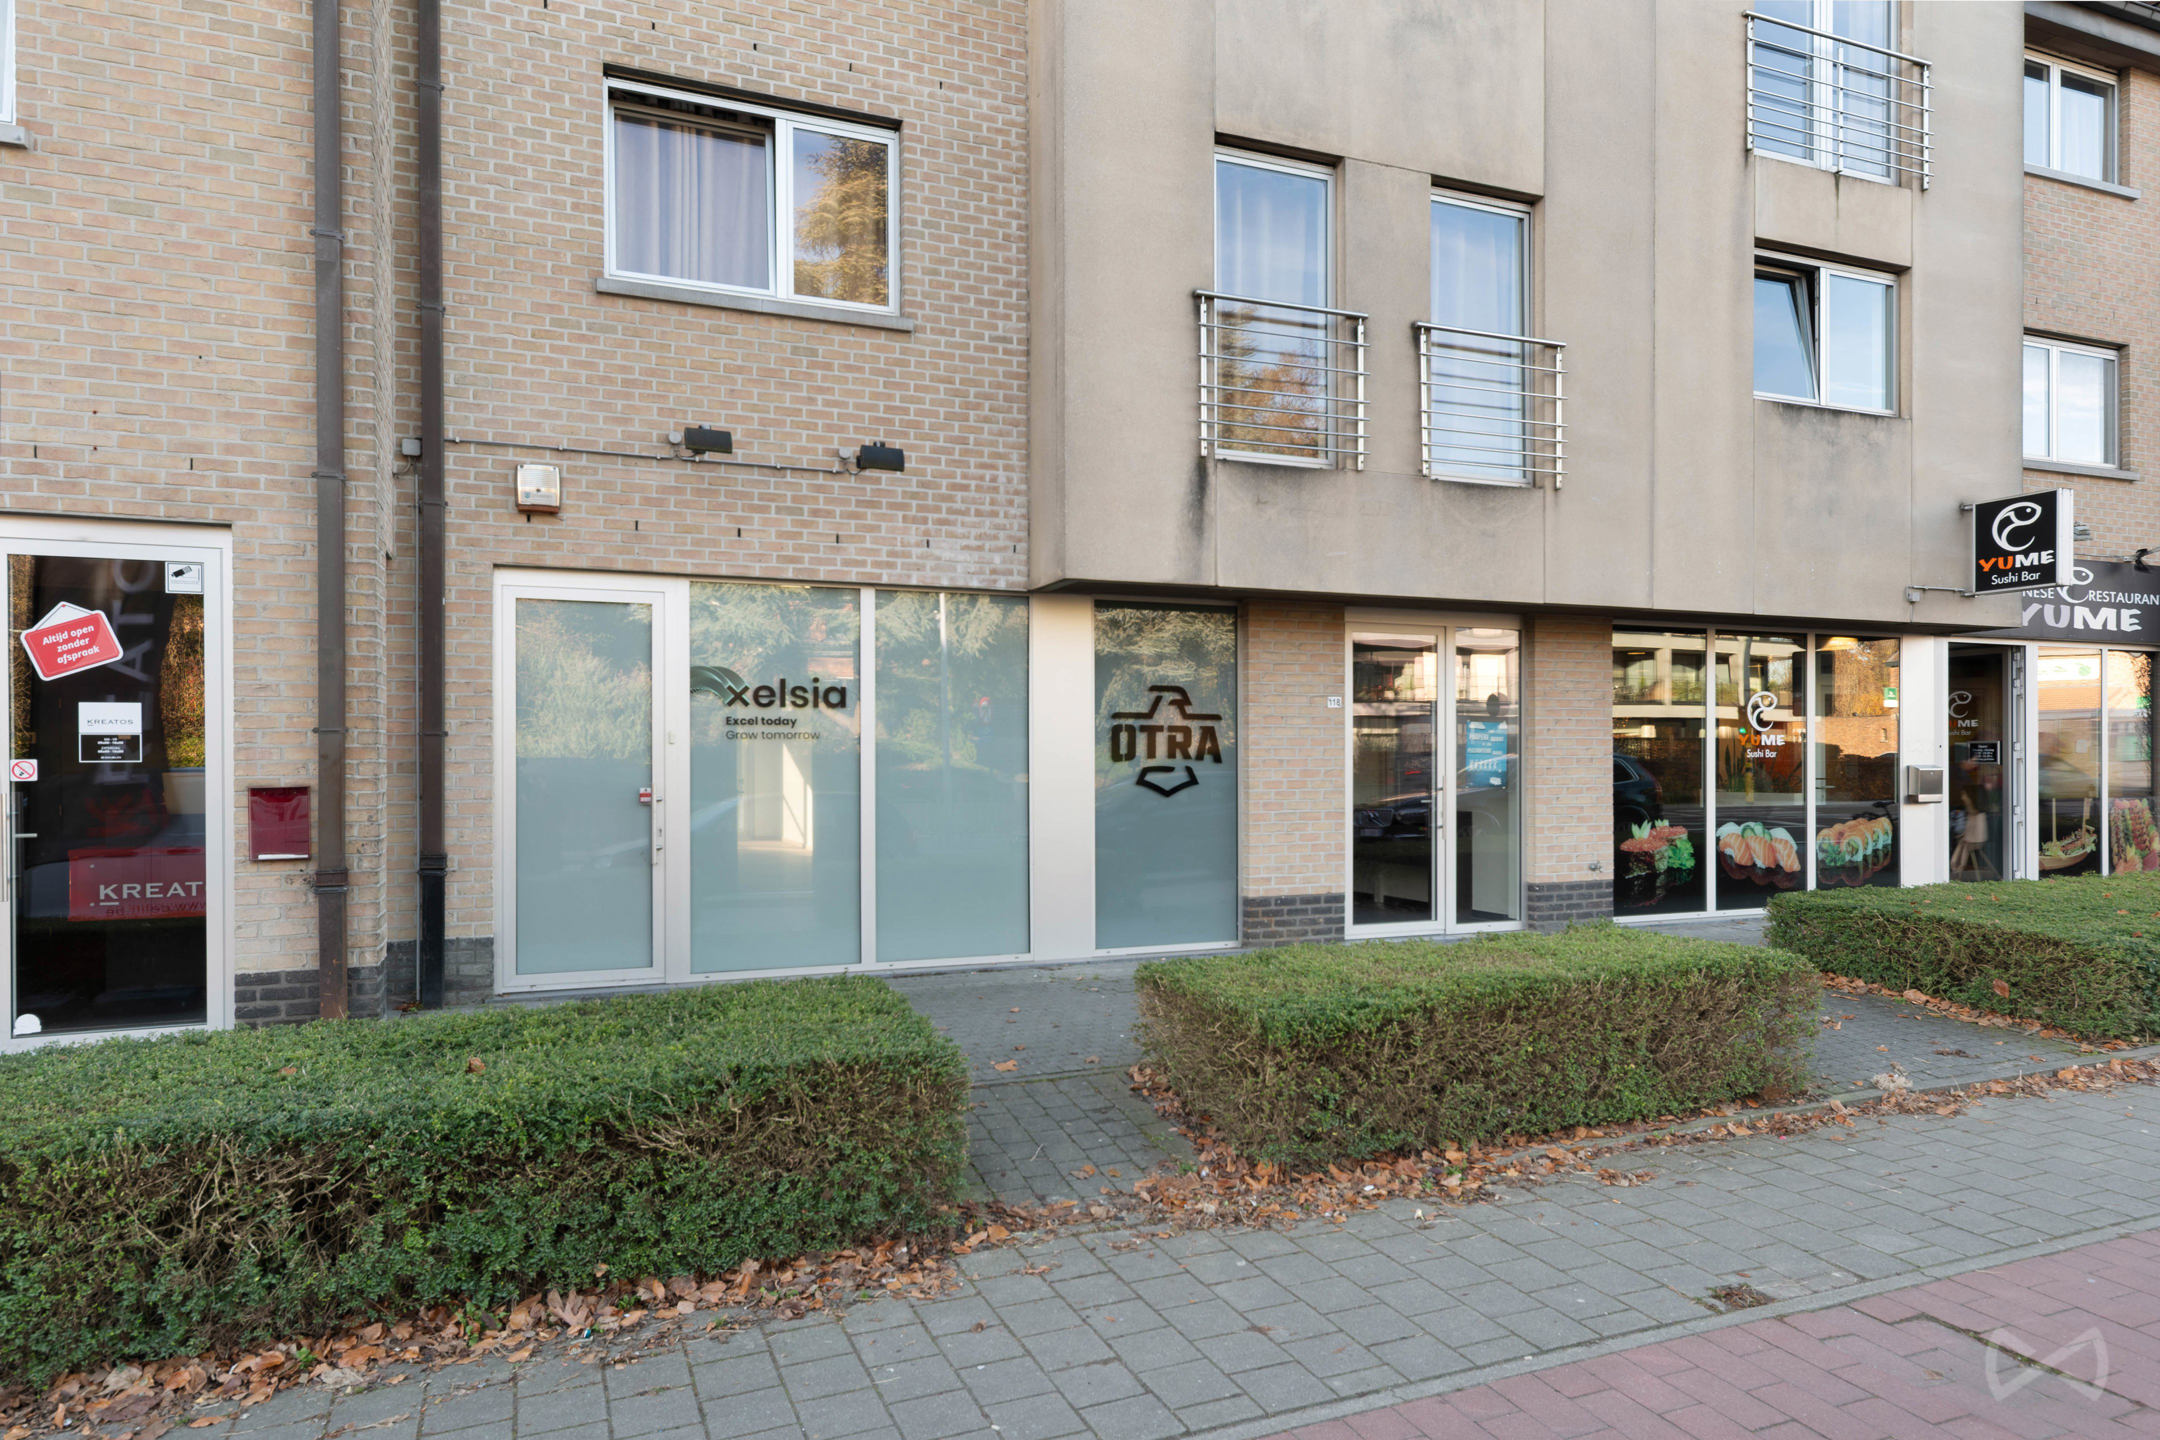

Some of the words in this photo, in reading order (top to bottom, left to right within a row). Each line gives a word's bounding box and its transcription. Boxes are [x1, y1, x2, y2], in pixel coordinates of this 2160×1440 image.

[1978, 549, 2055, 572] YUME
[1991, 572, 2018, 585] Sushi
[2021, 571, 2041, 582] Bar
[2022, 587, 2055, 599] NESE
[2088, 589, 2160, 606] RESTAURAN
[2022, 603, 2142, 632] YUME
[42, 631, 69, 645] Altijd
[70, 625, 95, 638] open
[57, 637, 90, 652] zonder
[57, 646, 100, 664] afspraak
[726, 677, 847, 708] xelsia
[725, 716, 759, 726] Excel
[761, 716, 797, 729] today
[725, 730, 758, 740] Grow
[761, 731, 821, 740] tomorrow
[1111, 724, 1222, 764] OTRA
[1738, 734, 1785, 746] YUME
[1746, 748, 1764, 758] Sushi
[1765, 749, 1777, 758] Bar
[99, 881, 206, 900] KREAT
